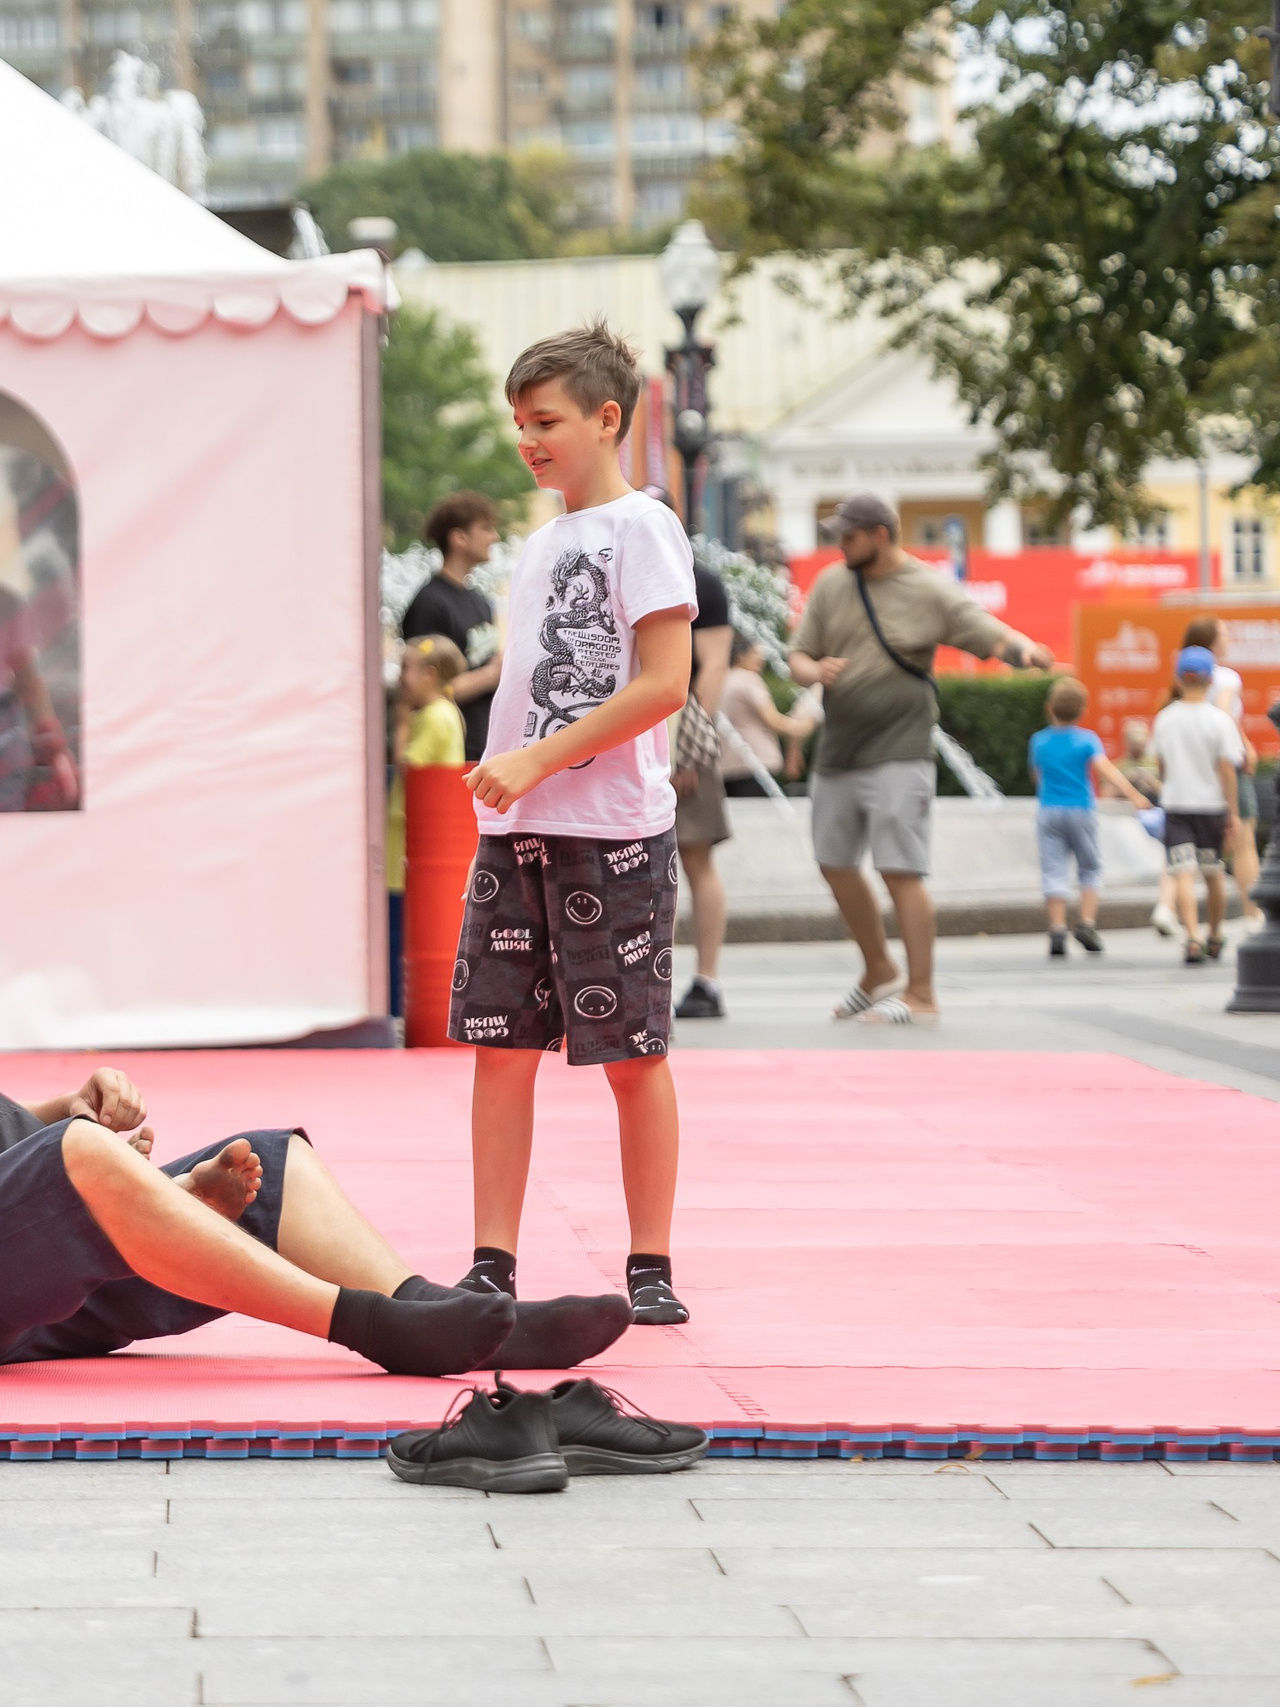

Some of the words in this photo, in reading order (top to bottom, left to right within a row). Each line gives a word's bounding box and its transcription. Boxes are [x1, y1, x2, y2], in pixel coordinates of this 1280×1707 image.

[578, 631, 620, 644] WISDOM
[574, 640, 622, 653] DRAGONS
[585, 649, 617, 659] TESTED
[575, 659, 621, 671] CENTURIES
[603, 841, 644, 865] MUSIC
[490, 940, 533, 951] MUSIC
[463, 1015, 508, 1029] MUSIC
